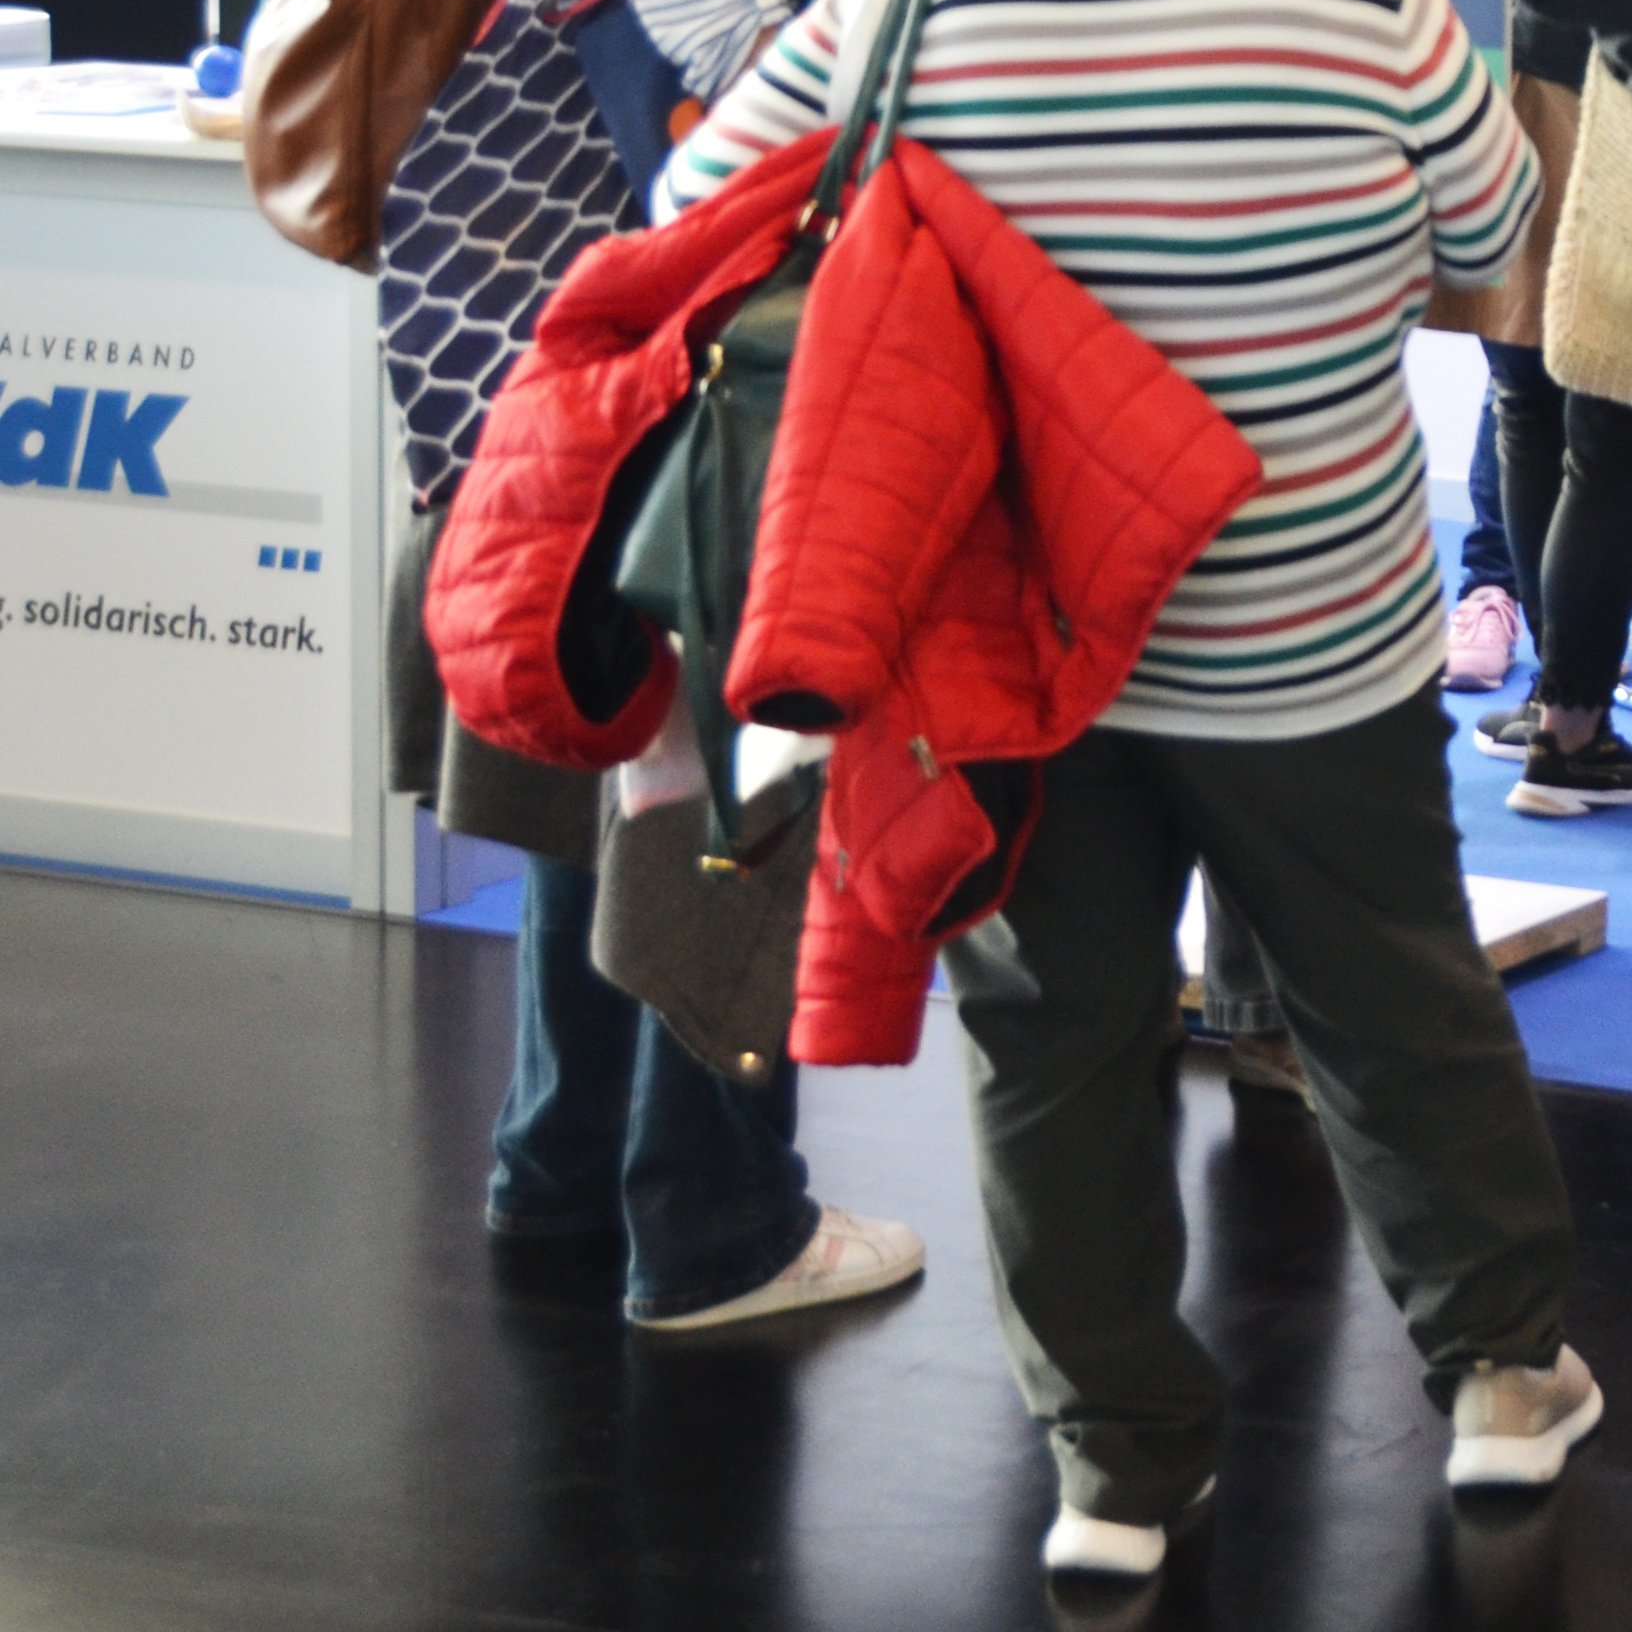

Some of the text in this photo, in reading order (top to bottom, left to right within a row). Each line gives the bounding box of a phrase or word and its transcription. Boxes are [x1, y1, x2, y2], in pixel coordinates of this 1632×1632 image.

[0, 333, 196, 371] ALVERBAND
[0, 381, 190, 497] dK
[24, 591, 216, 643] solidarisch.
[227, 616, 323, 654] stark.
